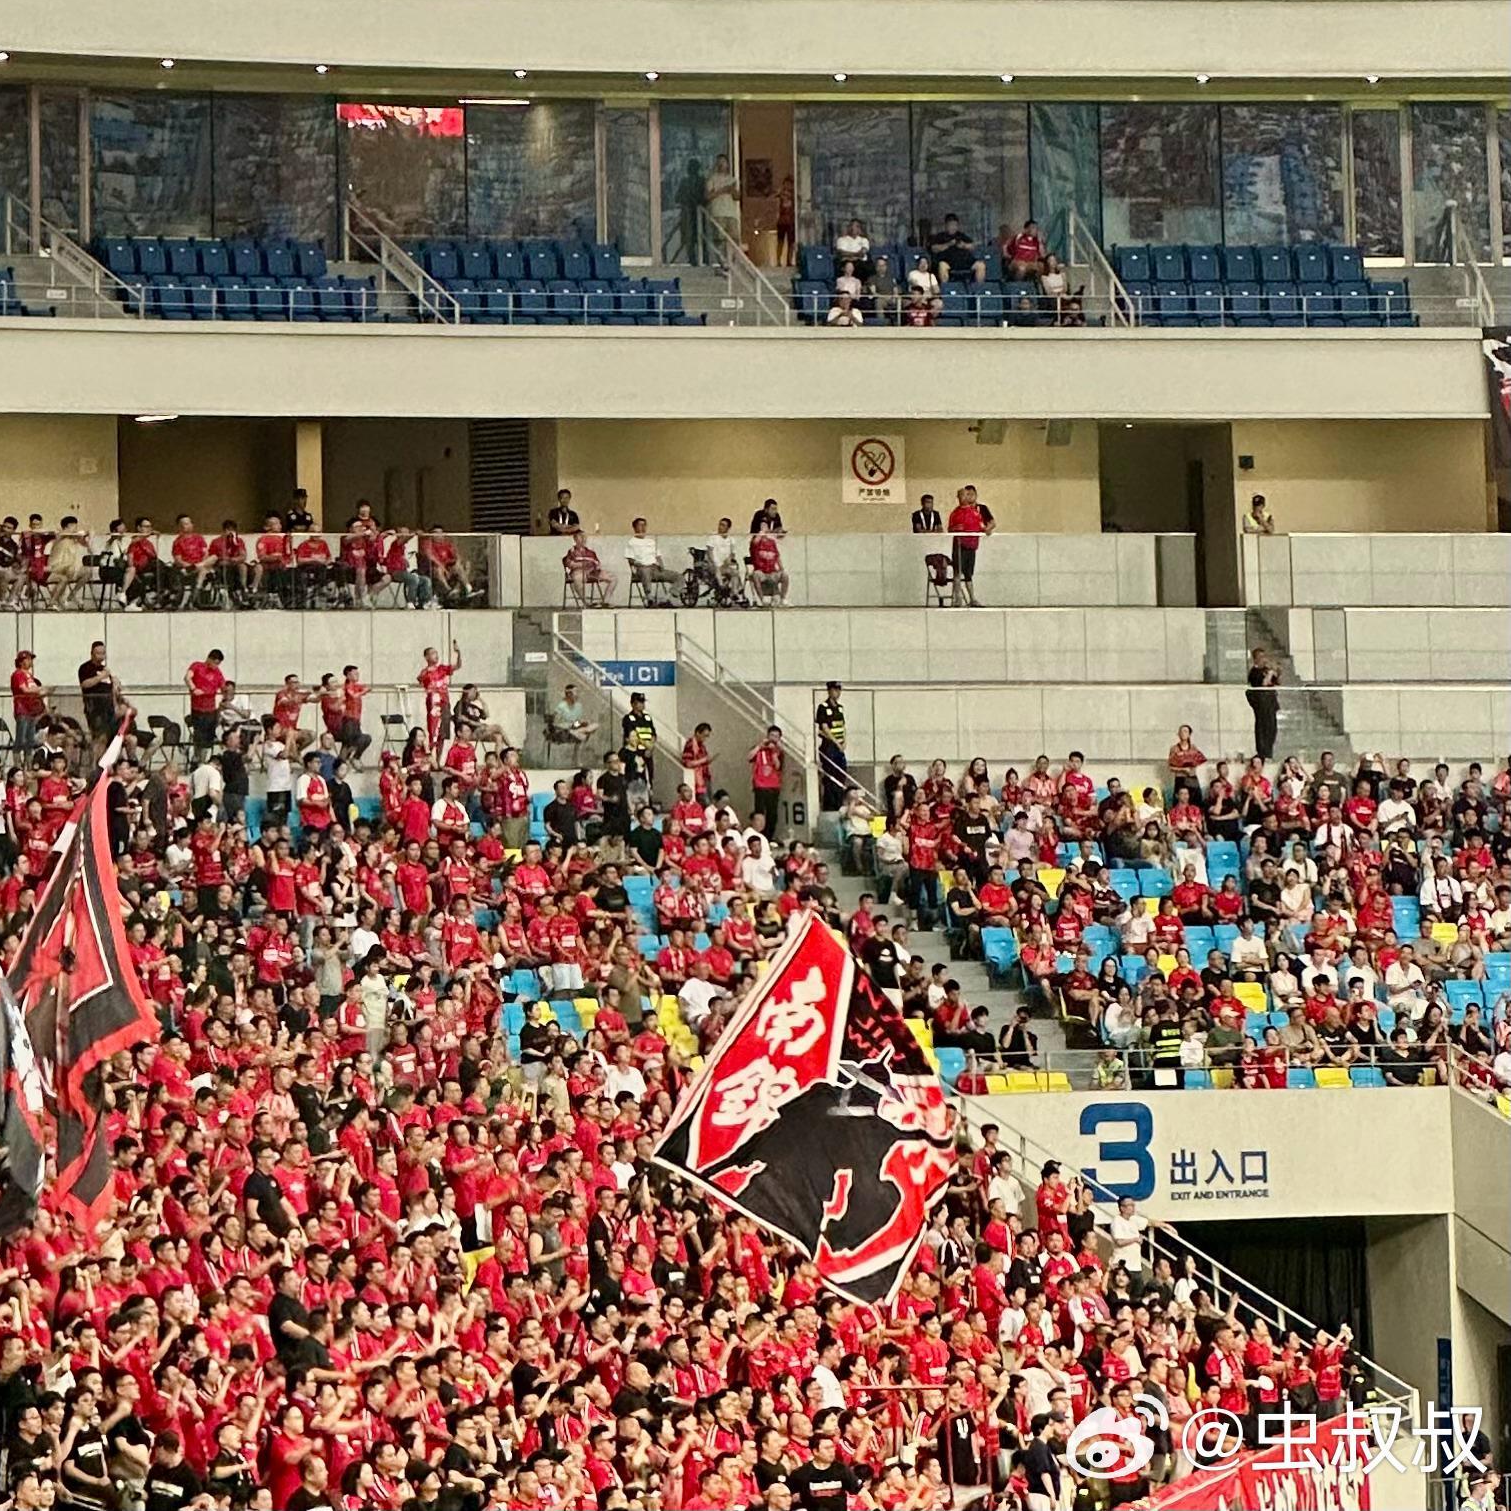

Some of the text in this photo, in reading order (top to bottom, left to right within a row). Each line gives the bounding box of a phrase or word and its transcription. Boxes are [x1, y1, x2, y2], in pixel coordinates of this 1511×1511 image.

[637, 666, 659, 682] C1
[782, 801, 805, 825] 16
[1080, 1102, 1268, 1203] 3 出入口
[1170, 1189, 1270, 1201] EXIT AND ENTRANCE
